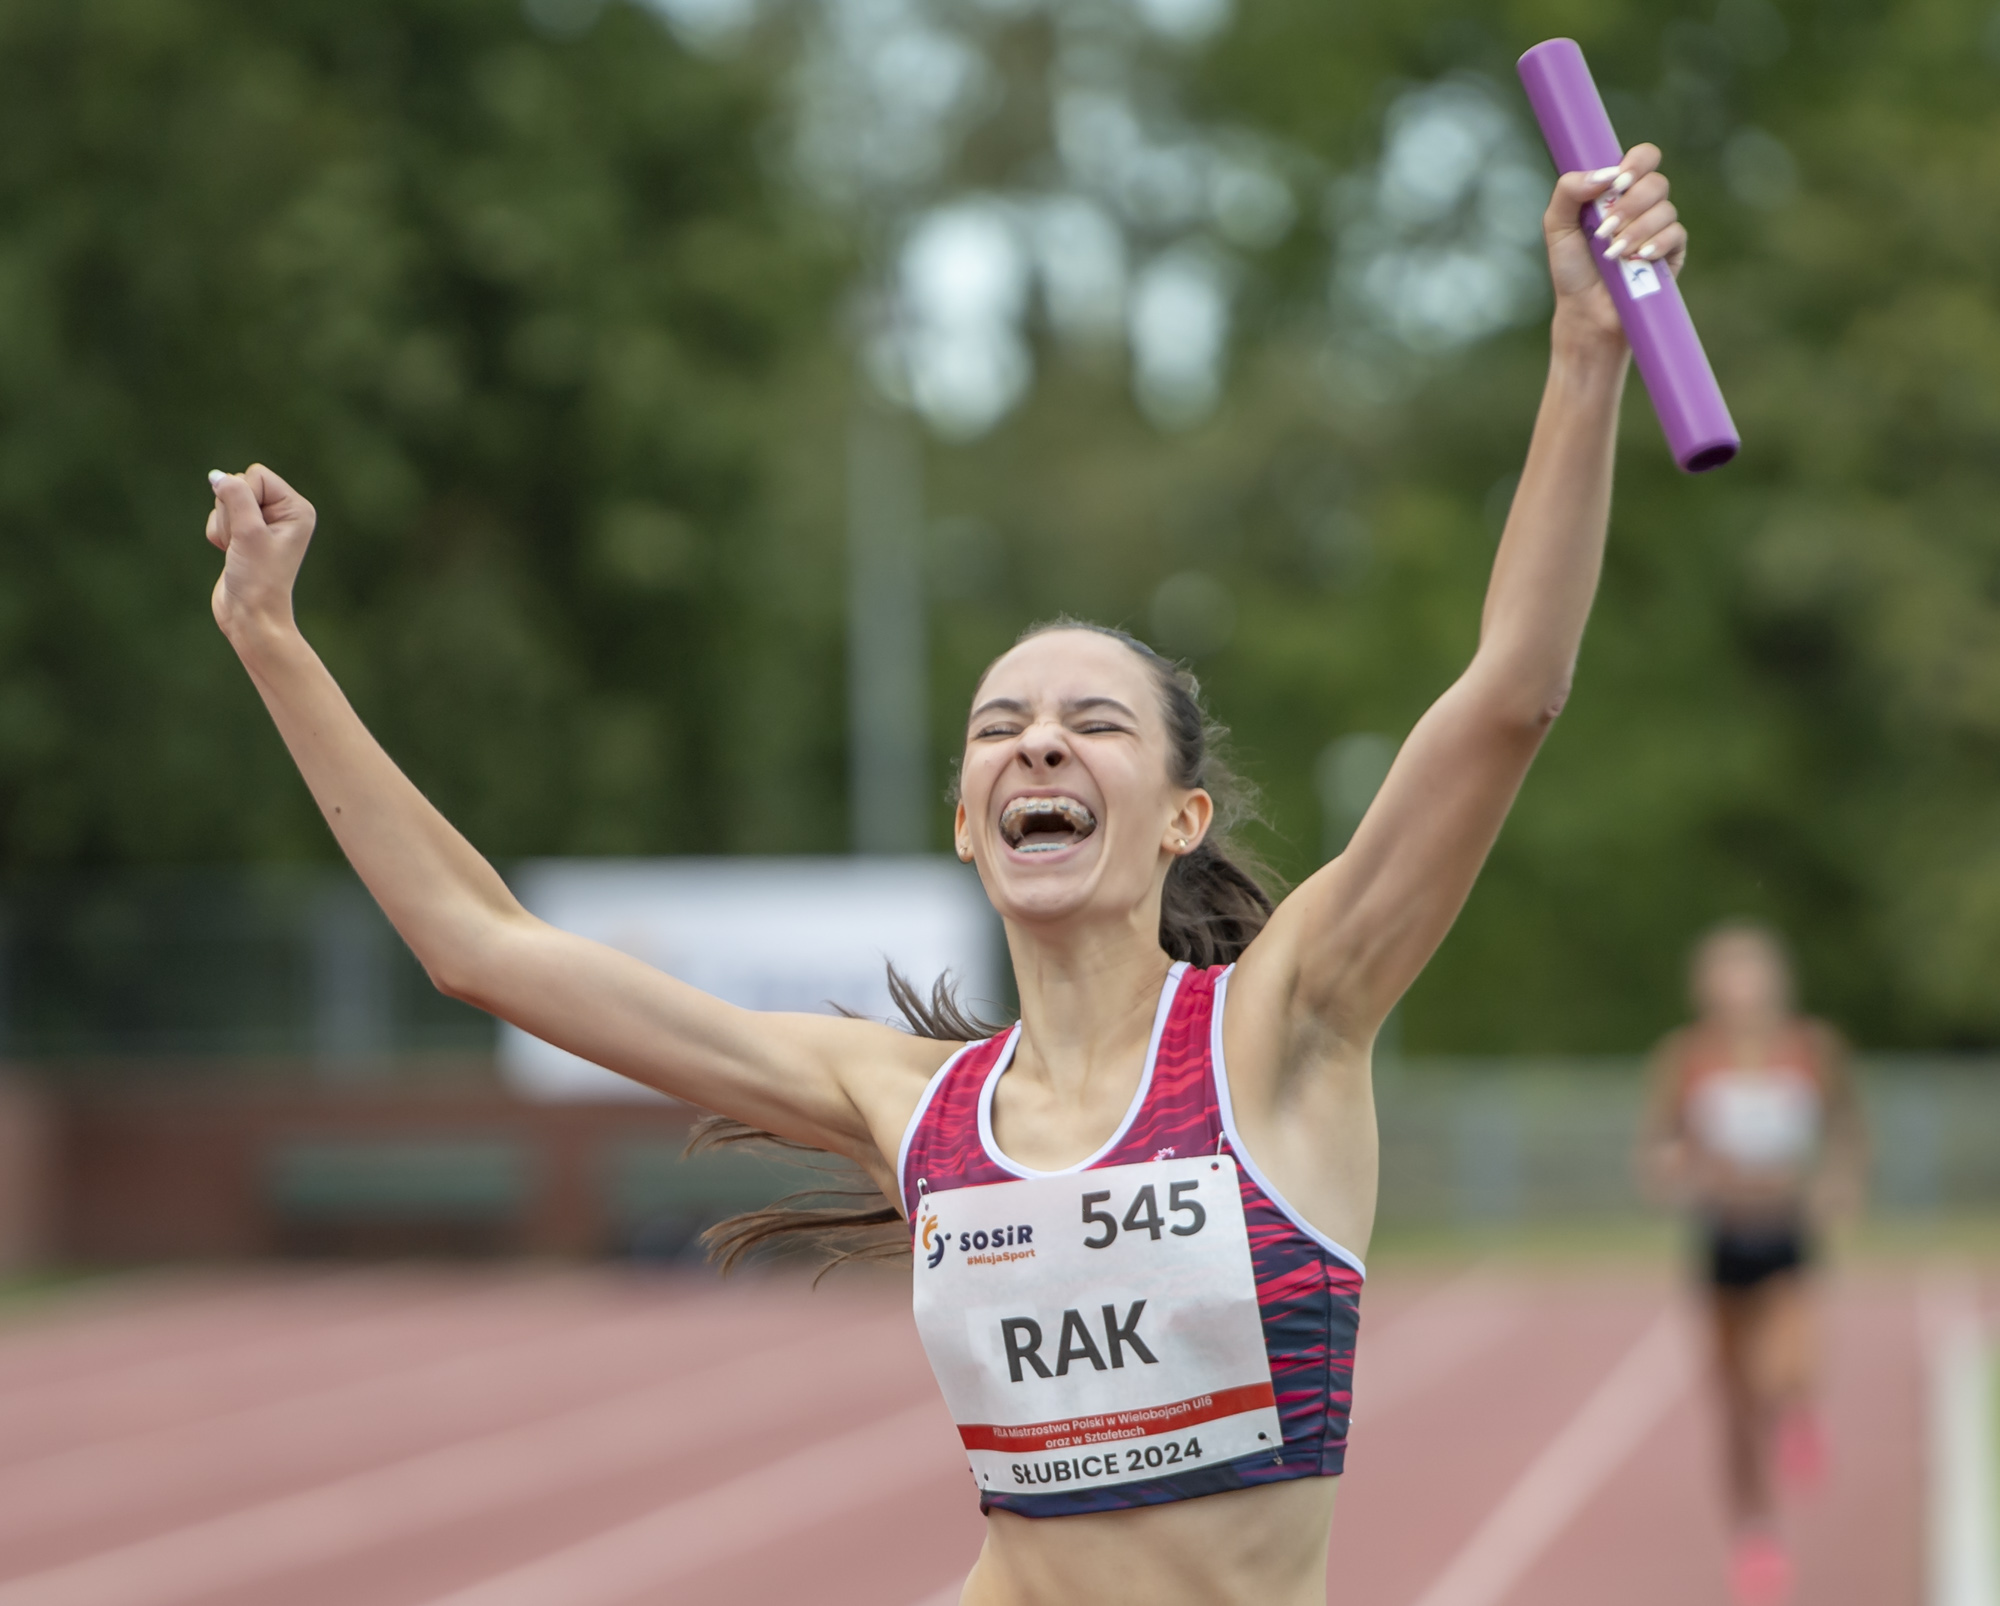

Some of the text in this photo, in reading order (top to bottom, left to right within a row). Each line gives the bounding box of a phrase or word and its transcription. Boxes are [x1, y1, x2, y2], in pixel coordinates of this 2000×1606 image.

[1082, 1180, 1206, 1249] 545
[959, 1224, 1033, 1252] SOSiR
[967, 1248, 1036, 1265] #MisjaSport
[1000, 1299, 1159, 1383] RAK
[1008, 1422, 1070, 1438] Mistrzostwa
[1072, 1415, 1104, 1430] Polski
[1106, 1416, 1116, 1426] w
[1117, 1401, 1191, 1425] Wielobojach
[1192, 1395, 1213, 1409] U16
[1045, 1426, 1146, 1448] oraz w Sztafetach
[1011, 1436, 1203, 1484] SŁUBICE 2024
